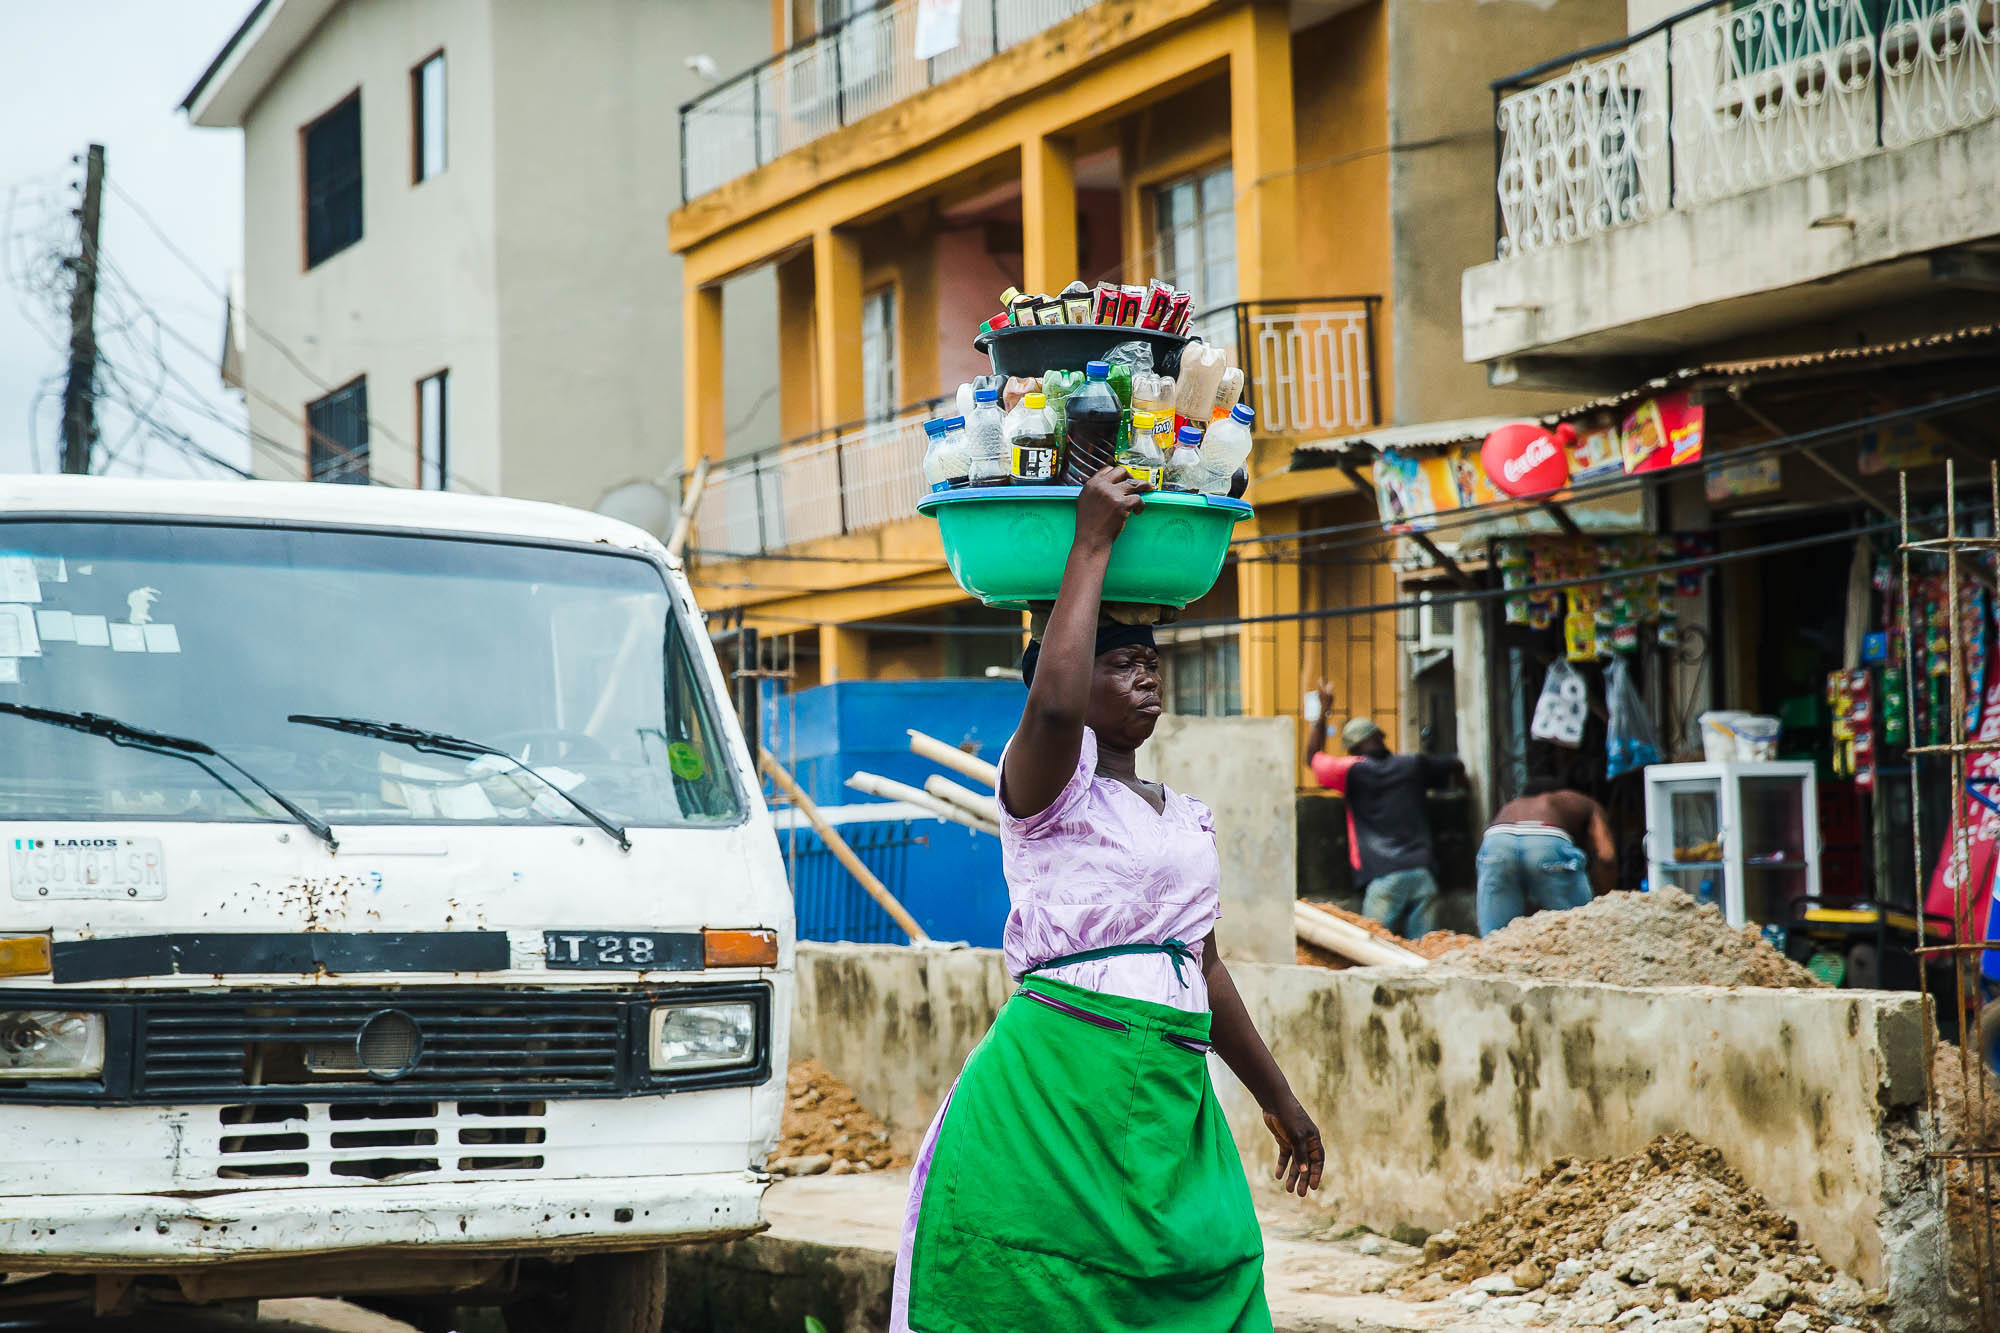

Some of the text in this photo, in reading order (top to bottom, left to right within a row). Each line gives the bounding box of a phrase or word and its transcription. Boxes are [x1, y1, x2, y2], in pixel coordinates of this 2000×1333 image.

[1038, 449, 1052, 478] BIG
[54, 839, 118, 847] LAGOS
[597, 935, 656, 963] 28
